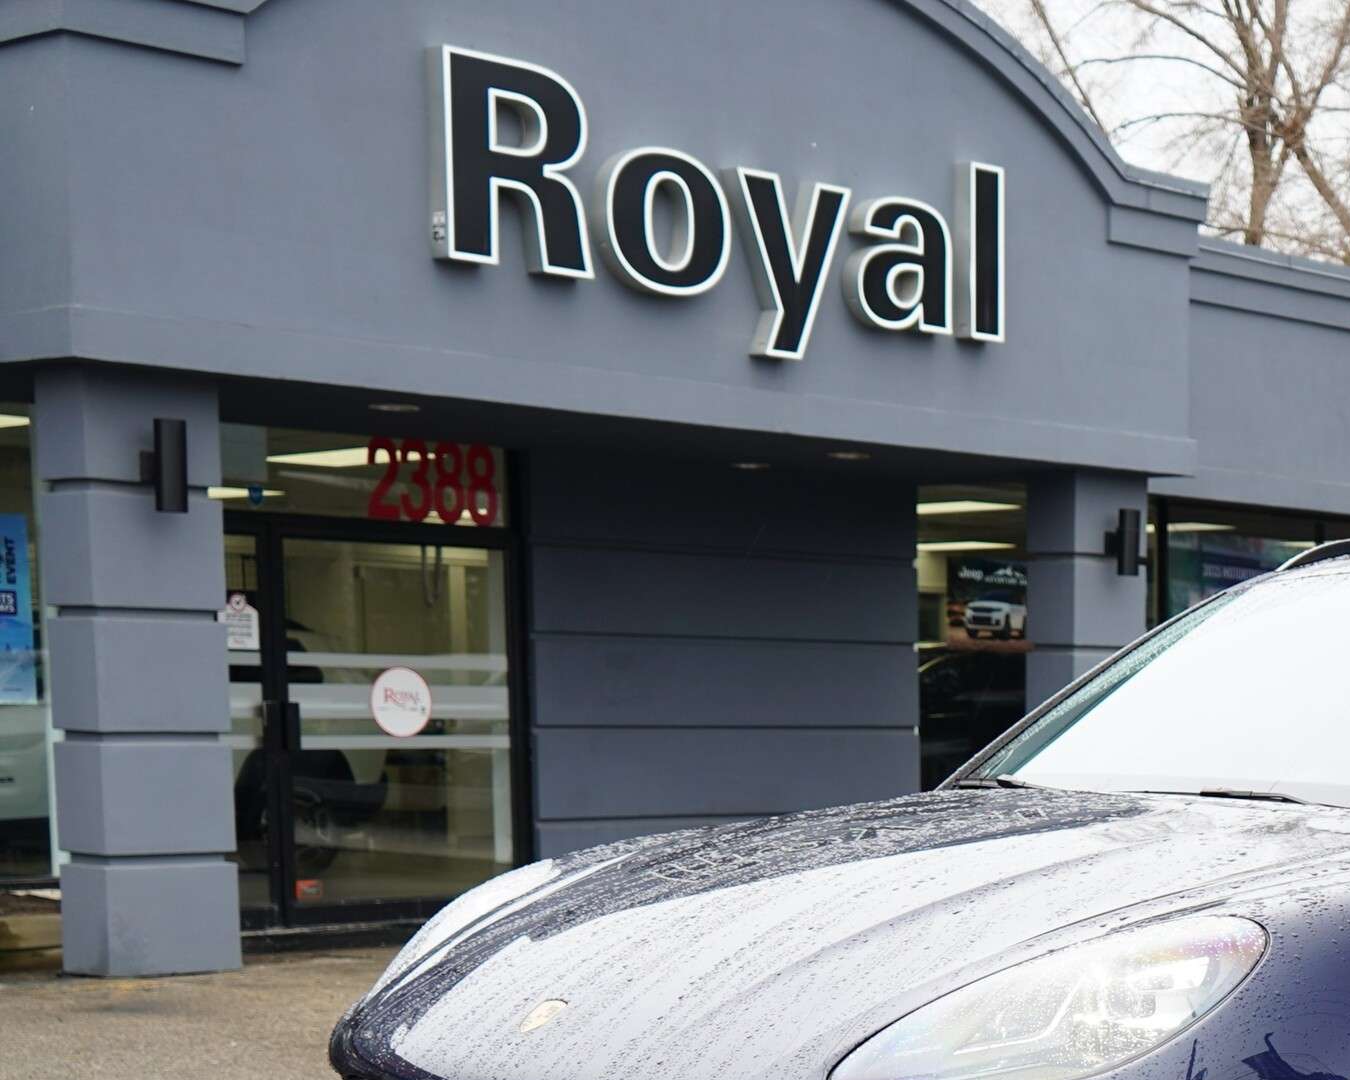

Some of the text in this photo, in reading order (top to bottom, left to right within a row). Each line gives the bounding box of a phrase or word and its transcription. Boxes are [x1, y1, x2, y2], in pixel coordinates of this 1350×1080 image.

[436, 44, 1005, 360] Royal
[368, 436, 497, 528] 2388
[958, 566, 983, 581] Jeep
